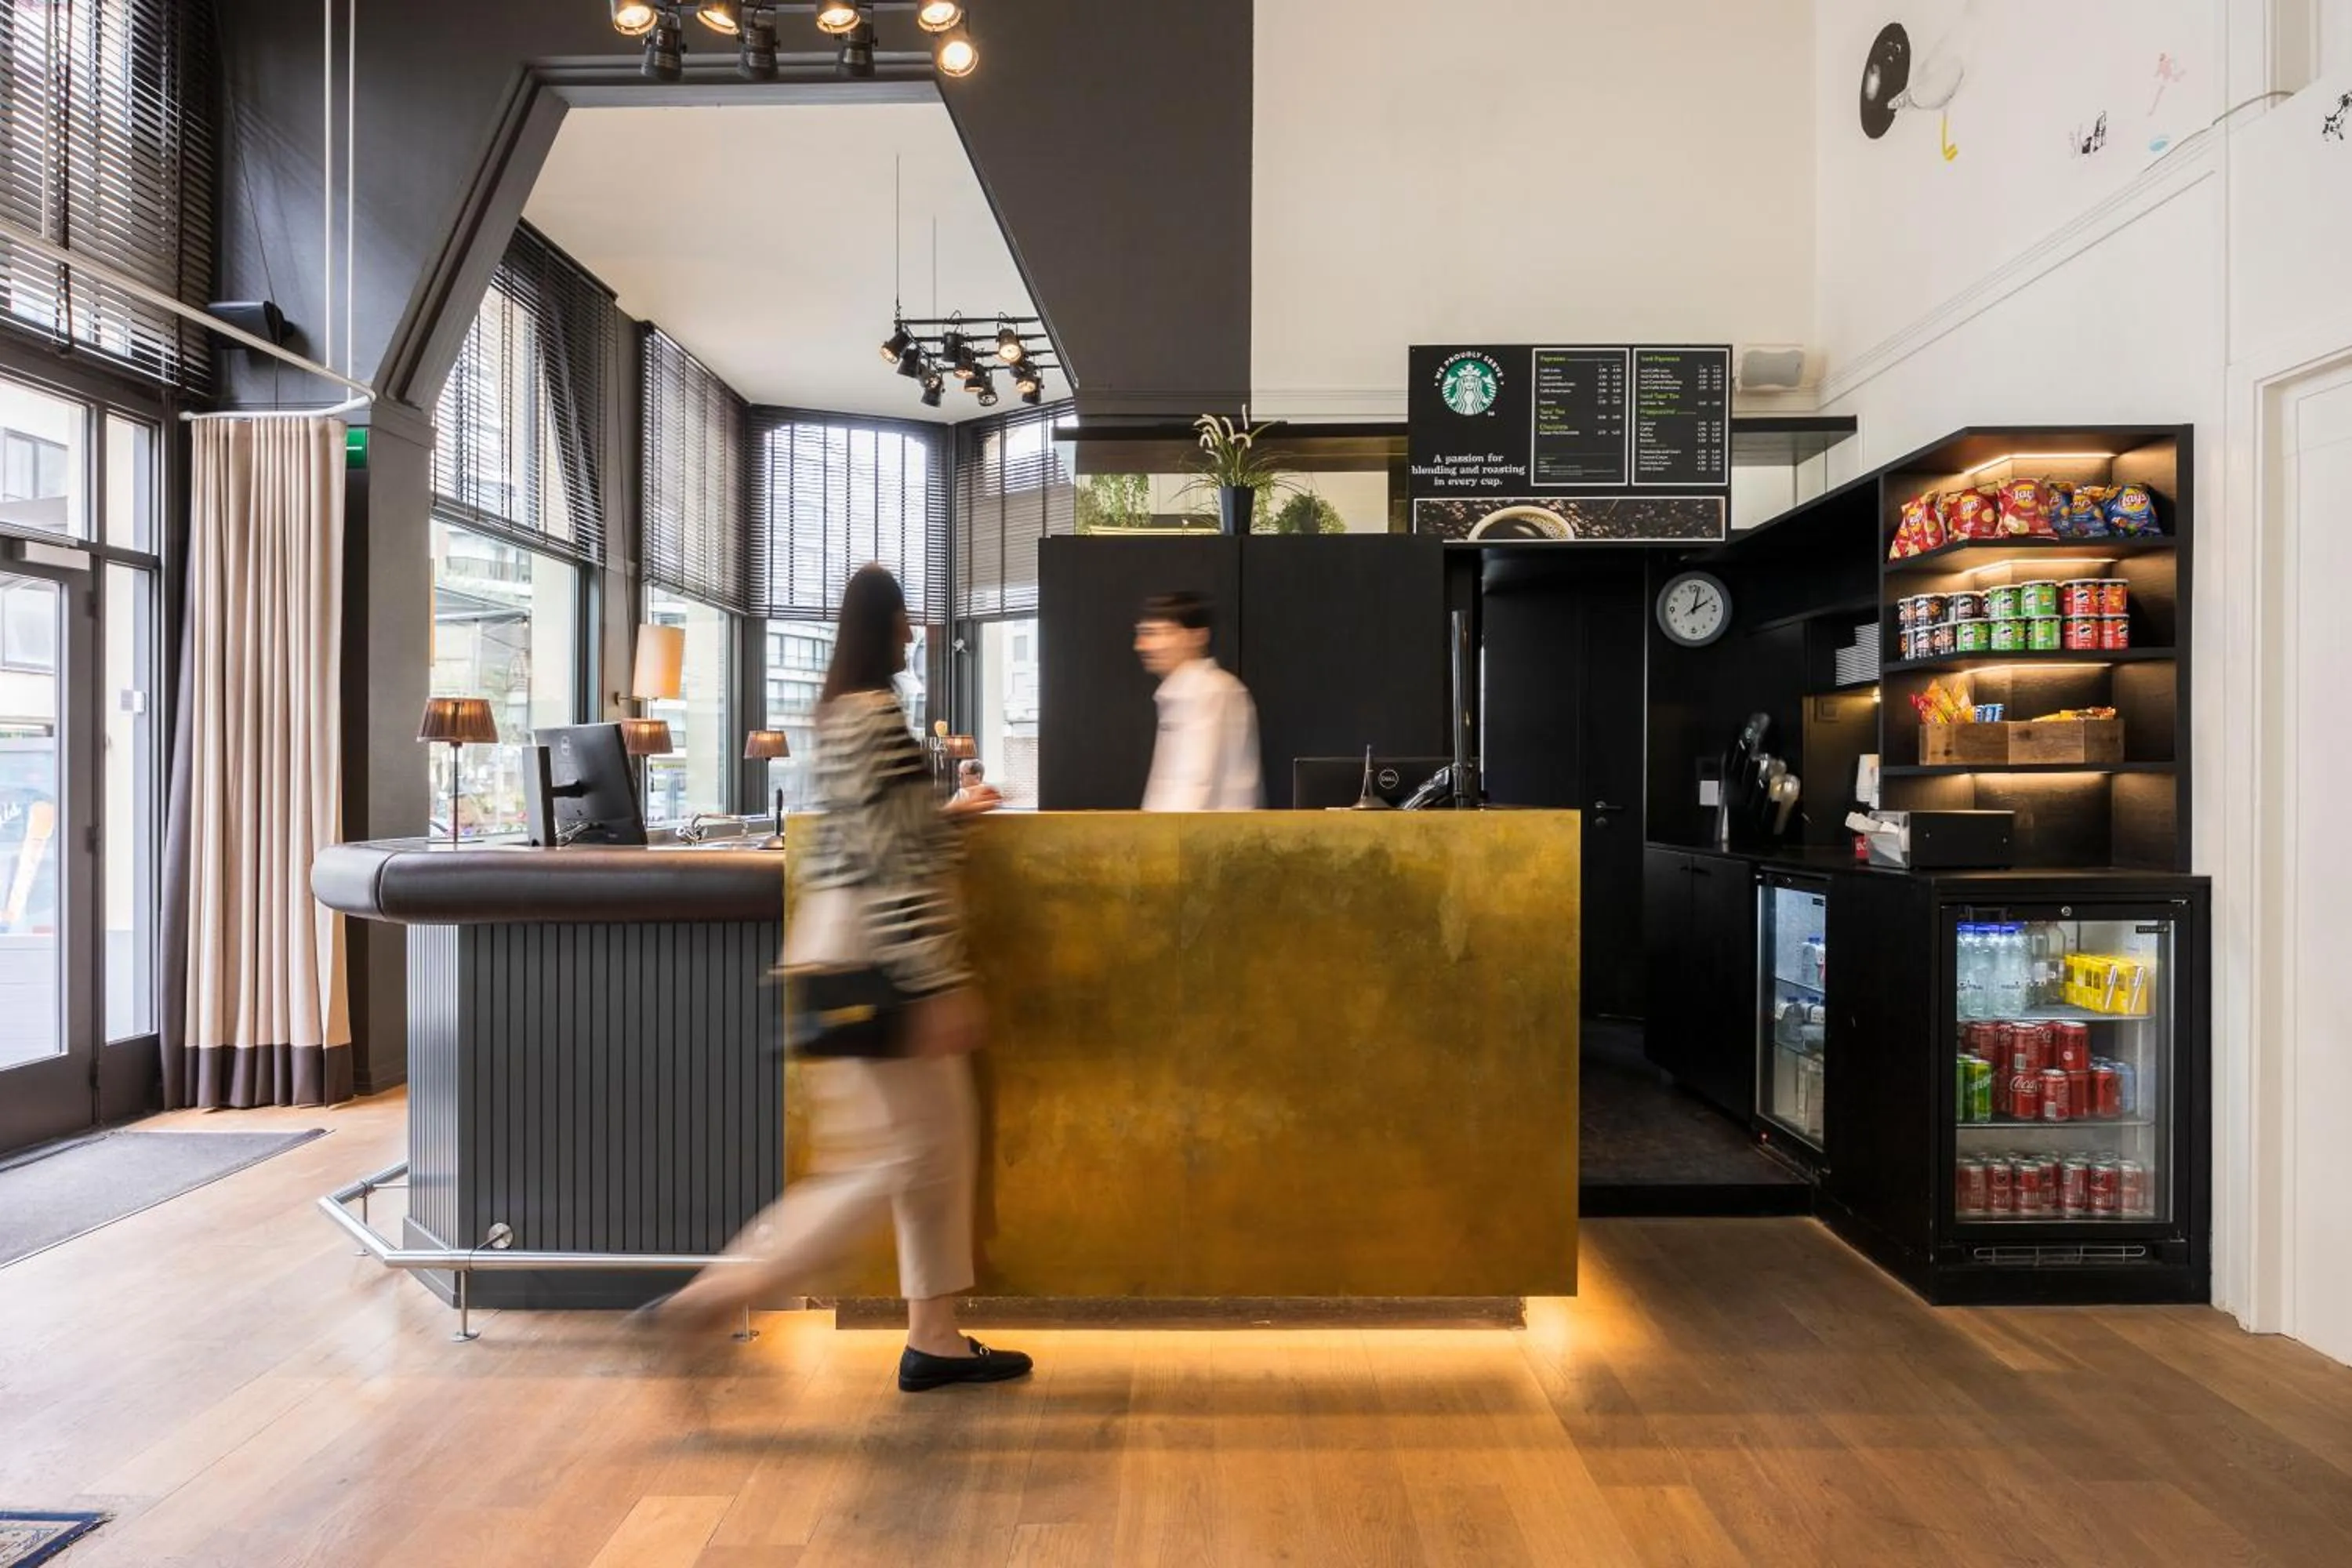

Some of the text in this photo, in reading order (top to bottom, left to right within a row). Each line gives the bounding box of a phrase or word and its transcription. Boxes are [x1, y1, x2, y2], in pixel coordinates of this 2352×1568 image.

[1435, 350, 1504, 379] WE PROUDLY SERVE
[1433, 452, 1504, 465] A passion for
[1411, 464, 1457, 476] blending
[1459, 465, 1479, 474] and
[1482, 464, 1526, 476] roasting
[1434, 476, 1503, 487] in every cup.
